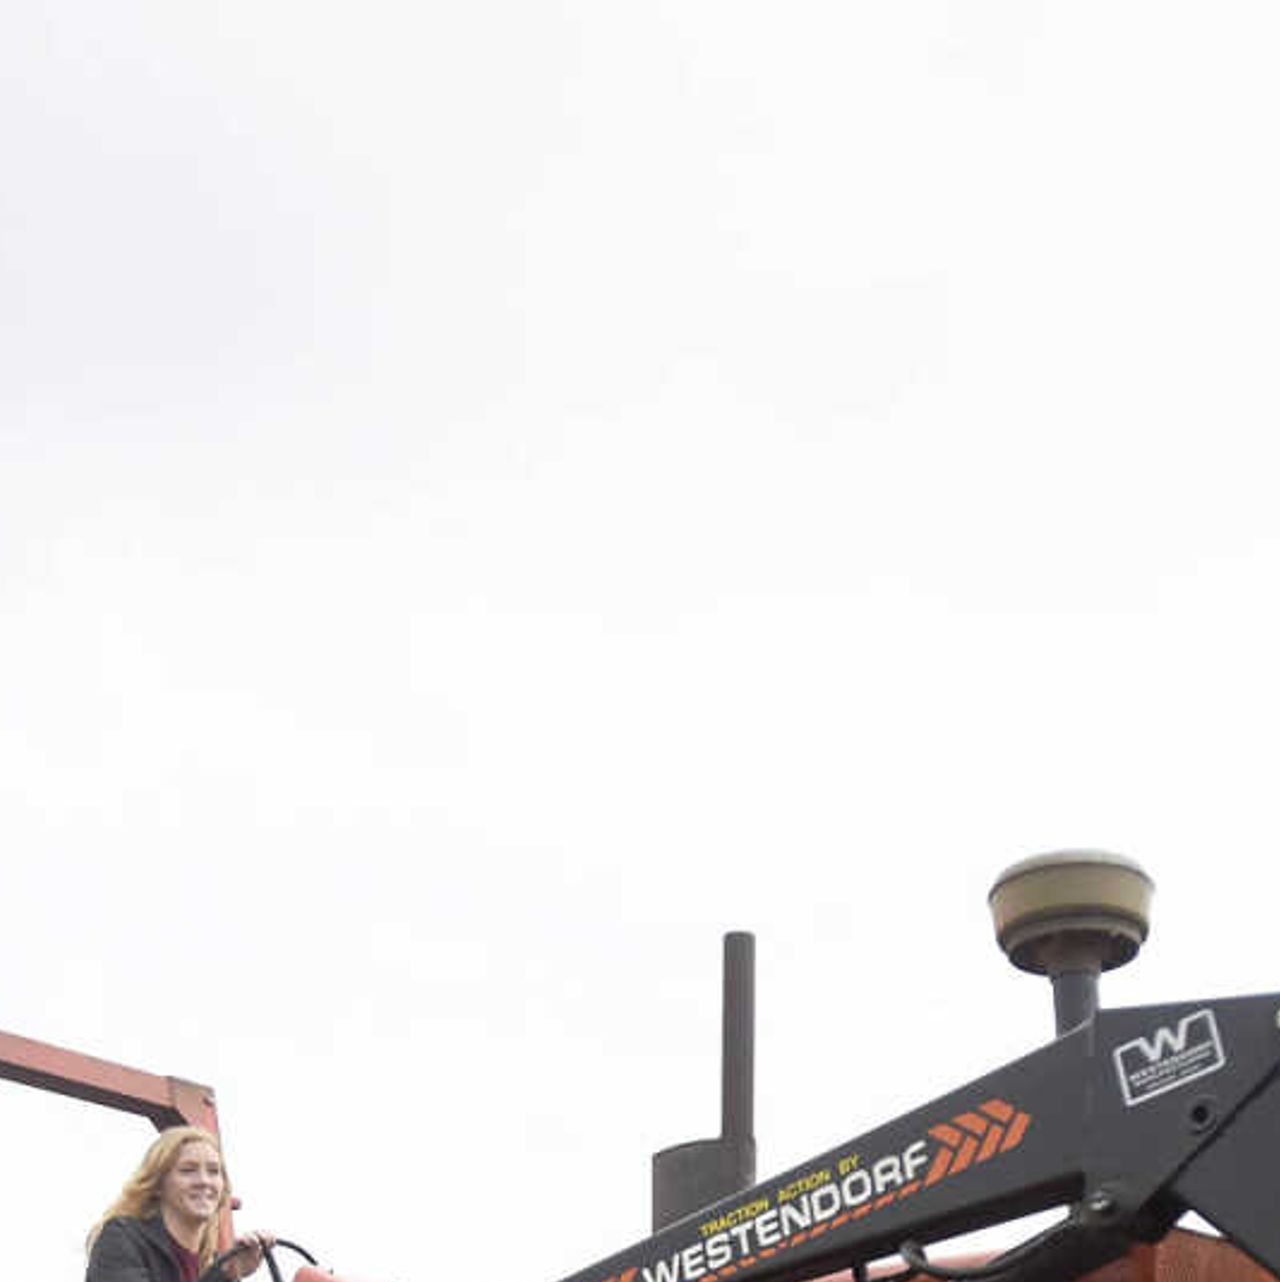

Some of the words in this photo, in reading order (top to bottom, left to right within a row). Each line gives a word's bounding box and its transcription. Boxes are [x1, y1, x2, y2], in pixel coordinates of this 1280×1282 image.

[699, 1198, 769, 1237] TRACTION
[777, 1170, 831, 1203] ACTION
[837, 1153, 862, 1175] BY
